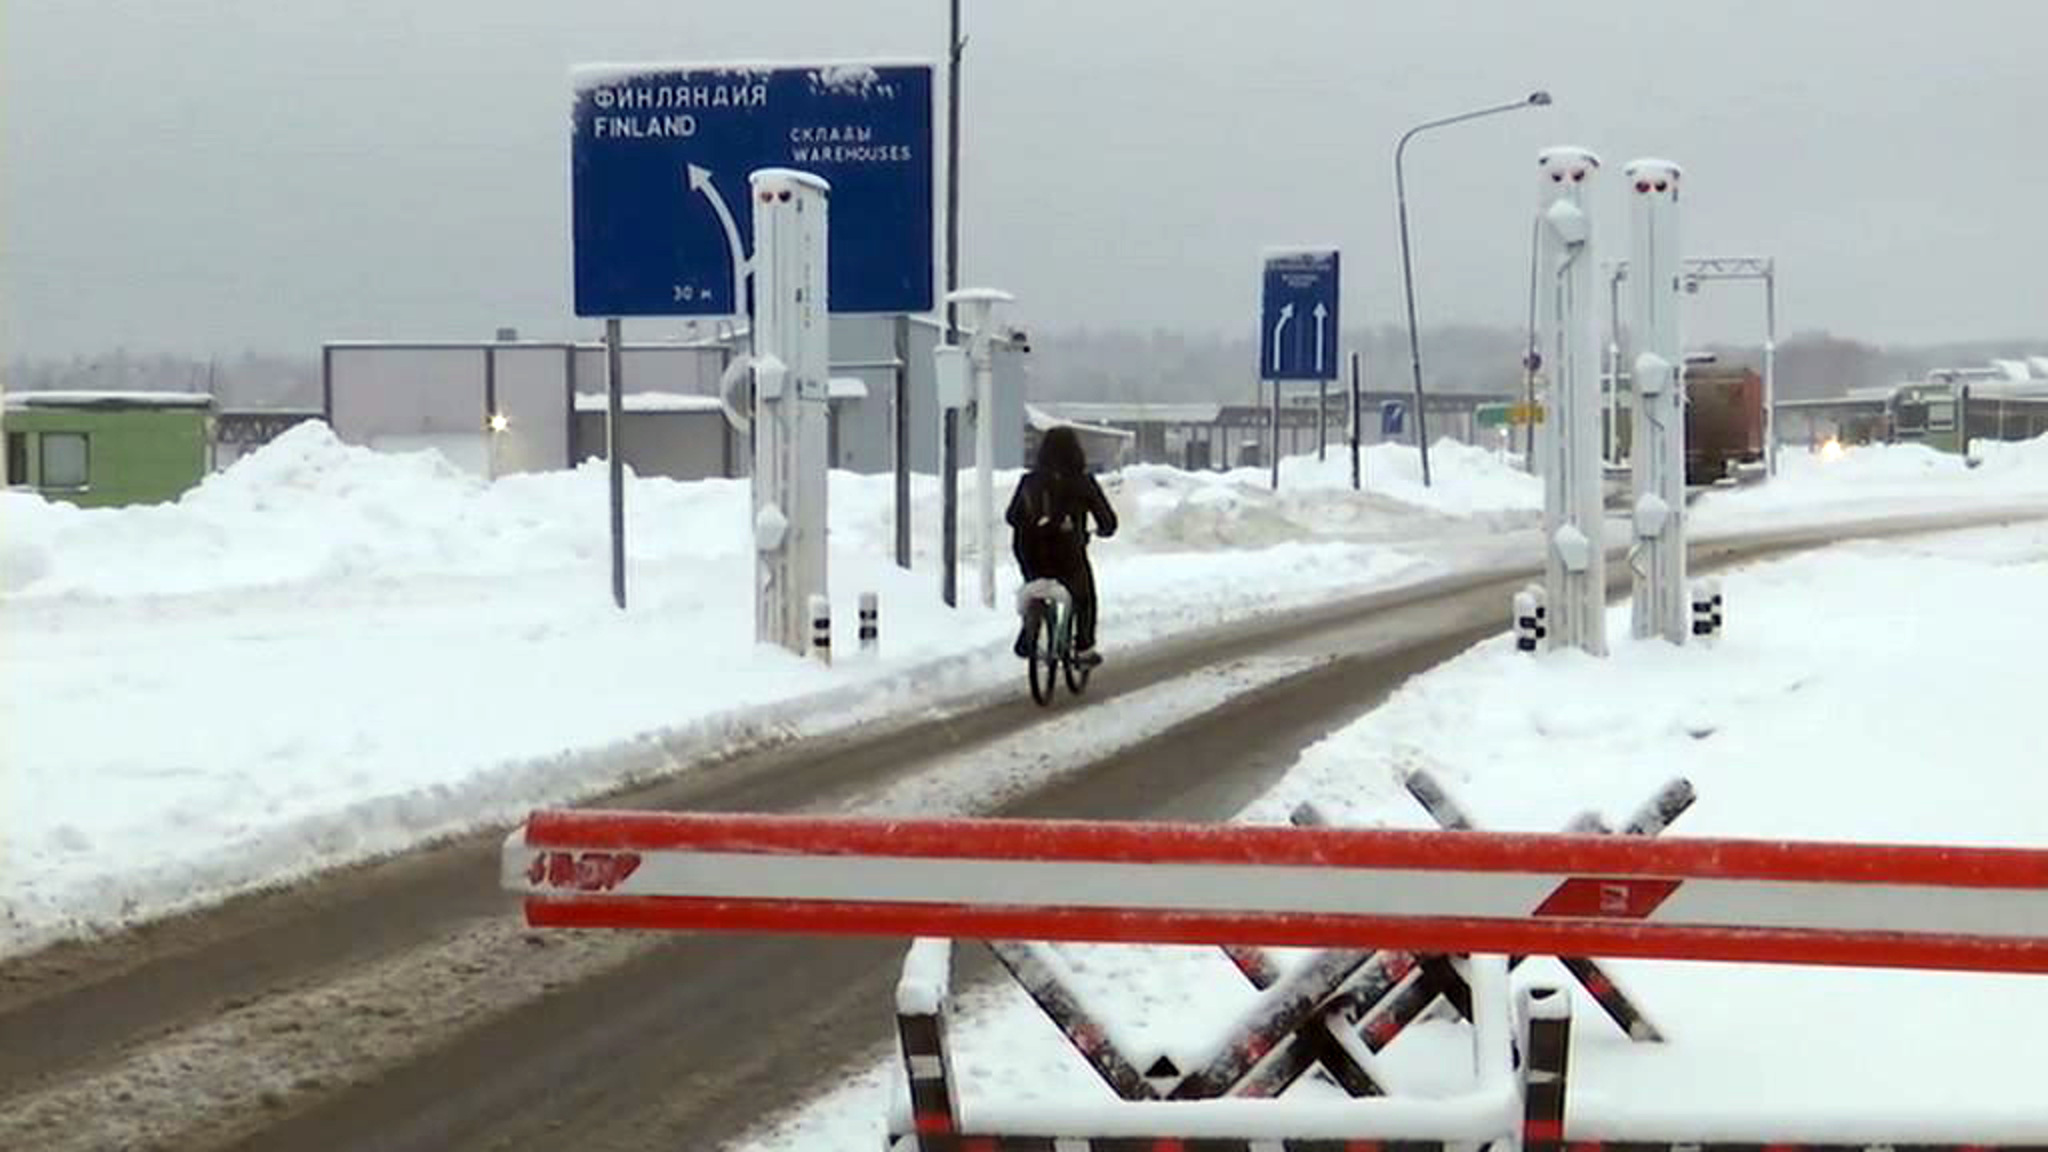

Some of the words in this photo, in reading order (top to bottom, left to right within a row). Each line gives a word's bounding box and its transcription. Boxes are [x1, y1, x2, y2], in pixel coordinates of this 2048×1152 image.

[593, 84, 767, 109] ФИНЛЯНДИЯ
[593, 114, 697, 138] FINLAND
[791, 145, 912, 162] WAREHOUSES
[672, 285, 693, 301] 30
